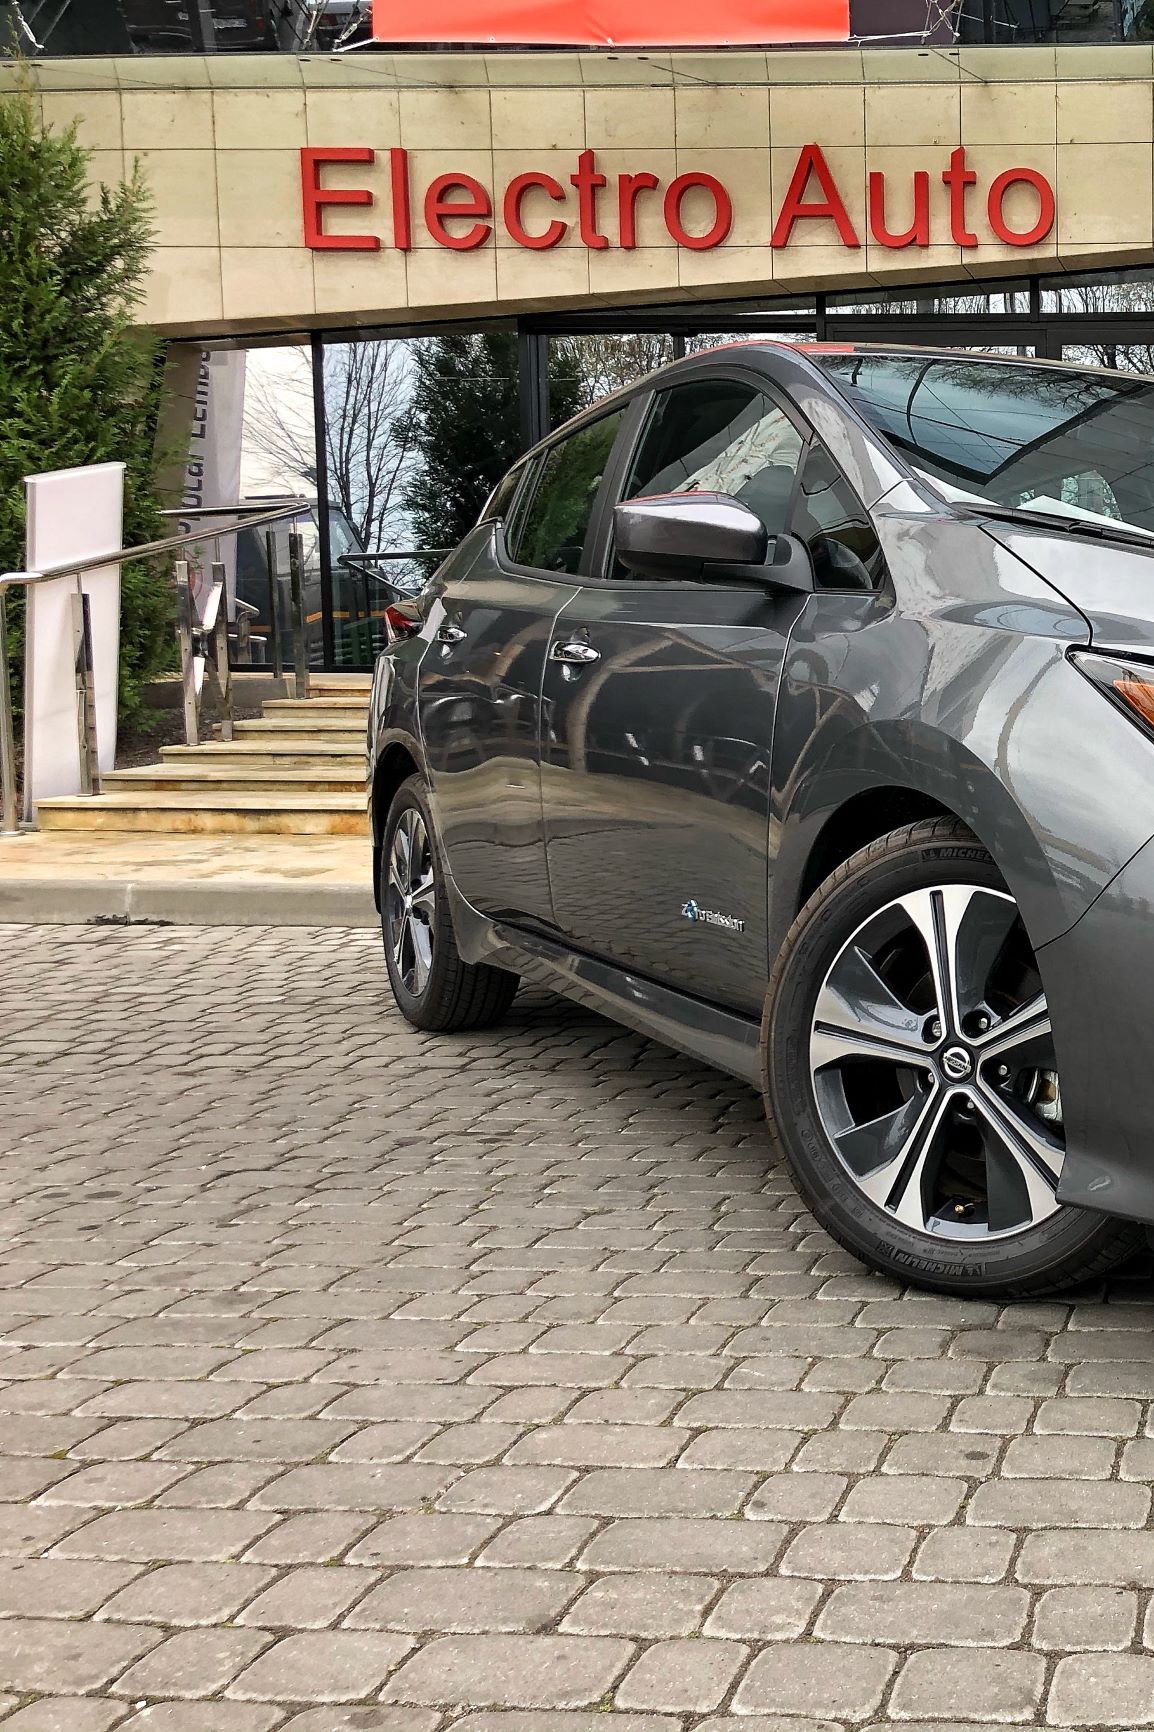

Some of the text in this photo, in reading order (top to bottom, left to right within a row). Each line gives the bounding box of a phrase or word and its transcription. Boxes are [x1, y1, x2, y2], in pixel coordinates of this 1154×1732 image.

[300, 143, 1056, 250] Electro Auto
[895, 1253, 964, 1276] MICHELIN
